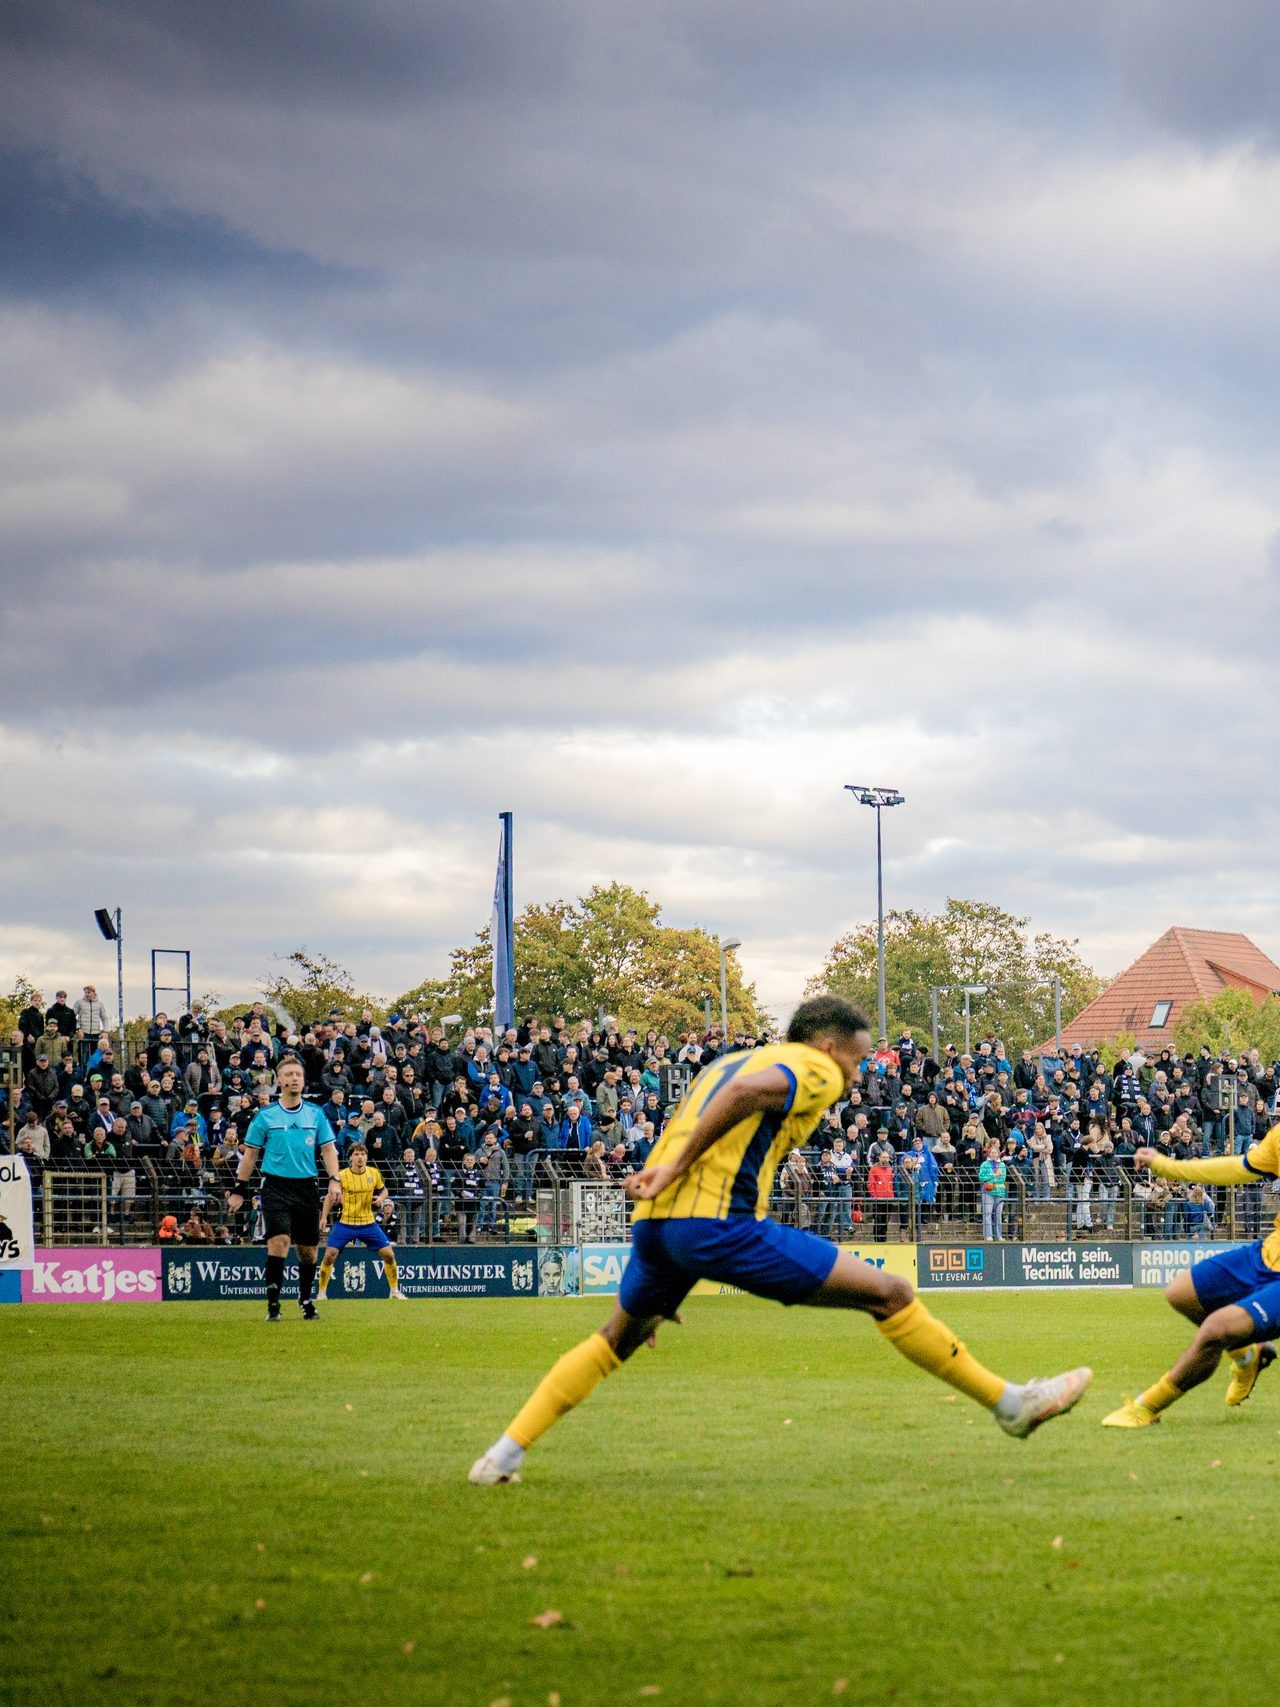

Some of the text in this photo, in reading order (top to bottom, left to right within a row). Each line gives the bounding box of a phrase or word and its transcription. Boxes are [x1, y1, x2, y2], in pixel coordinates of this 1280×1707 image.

[932, 1252, 981, 1268] TLT
[1022, 1247, 1112, 1263] Mensch sein,
[1141, 1249, 1190, 1265] RADIO
[931, 1273, 983, 1281] TLT EVENT AG
[1023, 1263, 1119, 1280] Technik leben!
[1141, 1268, 1161, 1284] IM
[32, 1260, 156, 1301] Katjes
